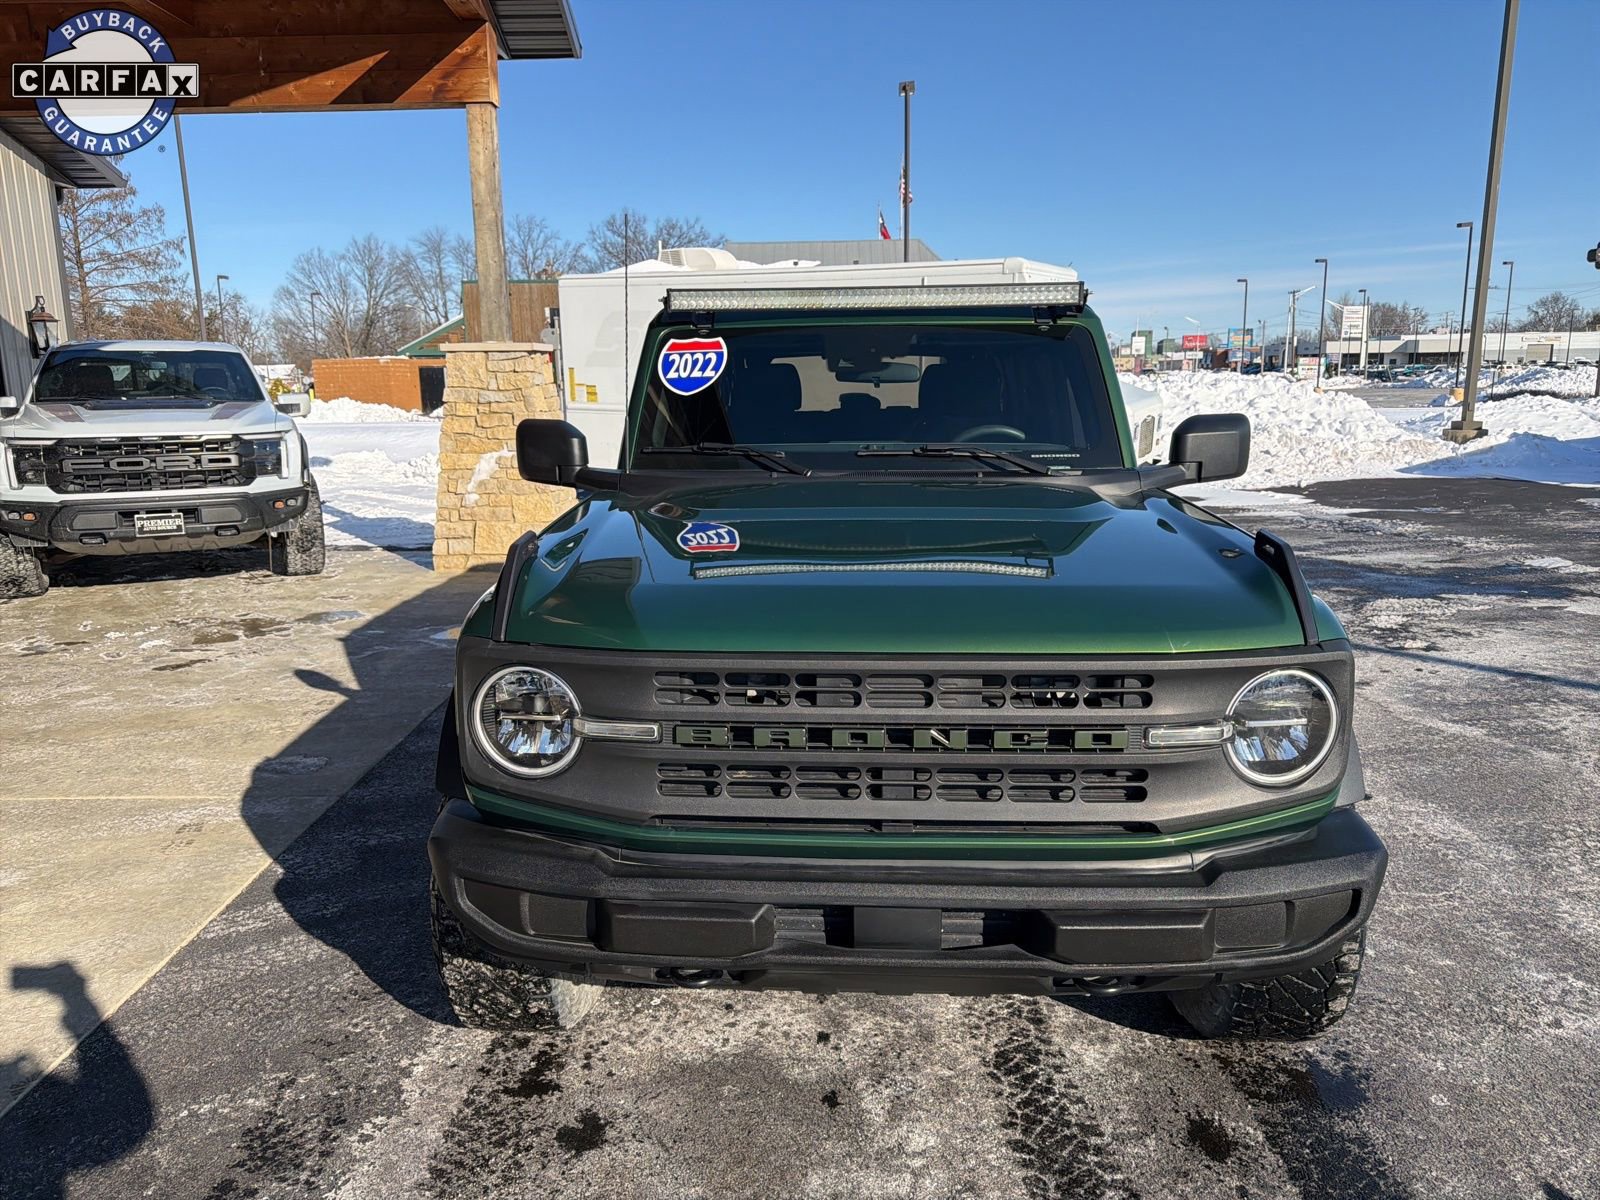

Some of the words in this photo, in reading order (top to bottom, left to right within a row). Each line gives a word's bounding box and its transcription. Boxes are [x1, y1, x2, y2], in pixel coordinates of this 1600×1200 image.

[666, 352, 717, 379] 2022
[62, 454, 240, 473] FORD
[137, 518, 183, 527] PREMIER
[675, 724, 1128, 750] BRONCO
